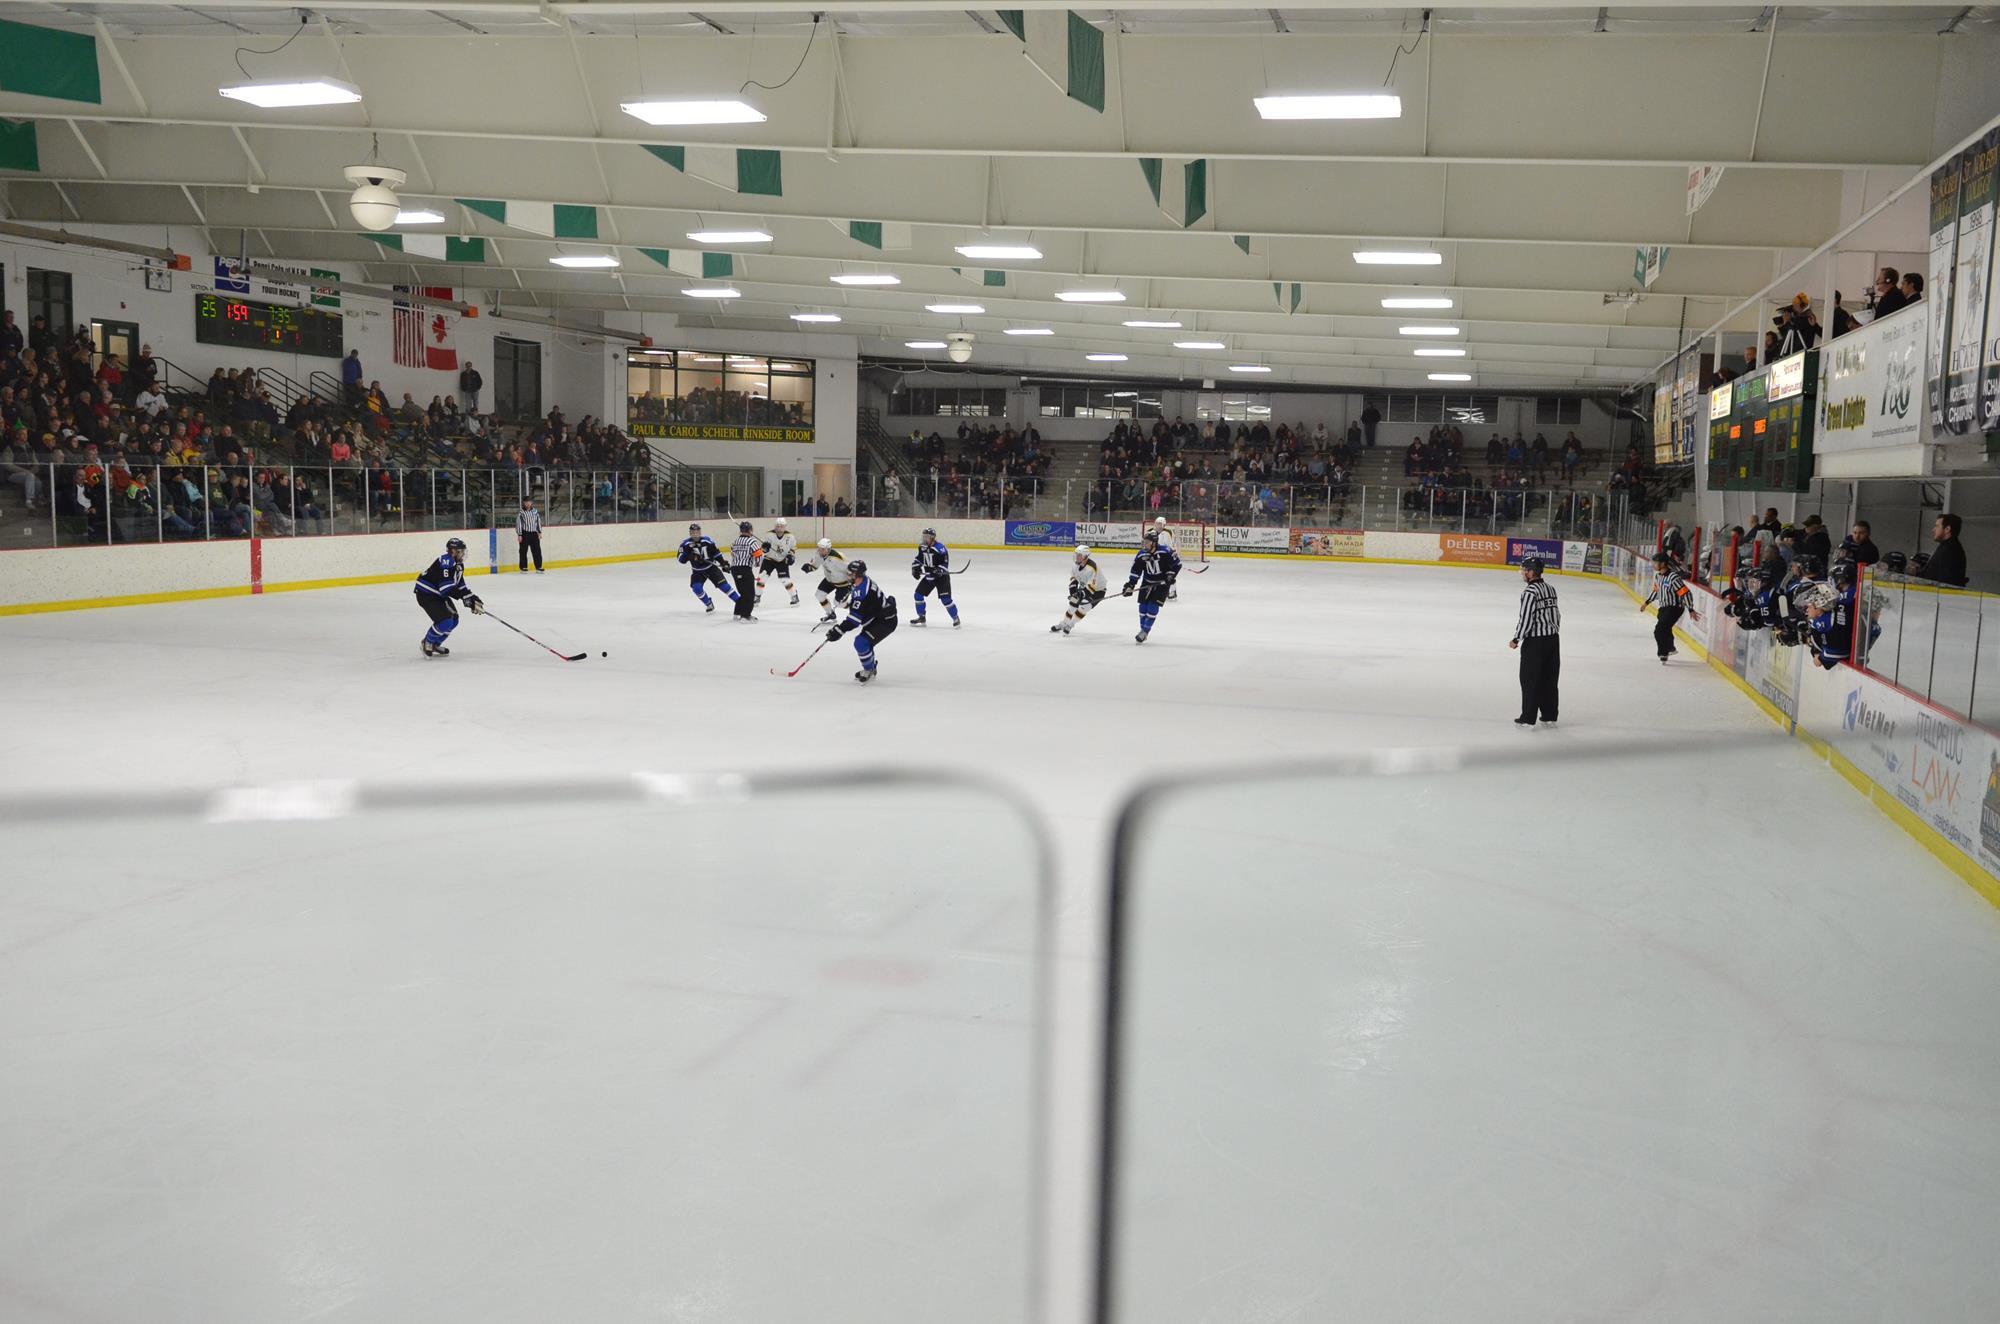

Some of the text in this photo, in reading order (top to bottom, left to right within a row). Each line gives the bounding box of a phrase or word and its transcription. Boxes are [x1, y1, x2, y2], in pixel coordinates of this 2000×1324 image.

[202, 300, 290, 324] 25 1:59 7:35
[633, 424, 811, 441] PAUL & CAROL SCHIERL RINKSIDE ROOM
[1080, 523, 1107, 535] HOW
[1222, 527, 1250, 539] HOW
[443, 568, 449, 578] 6
[1145, 560, 1161, 575] M
[1760, 606, 1770, 617] 15
[1858, 701, 1896, 740] NetNet
